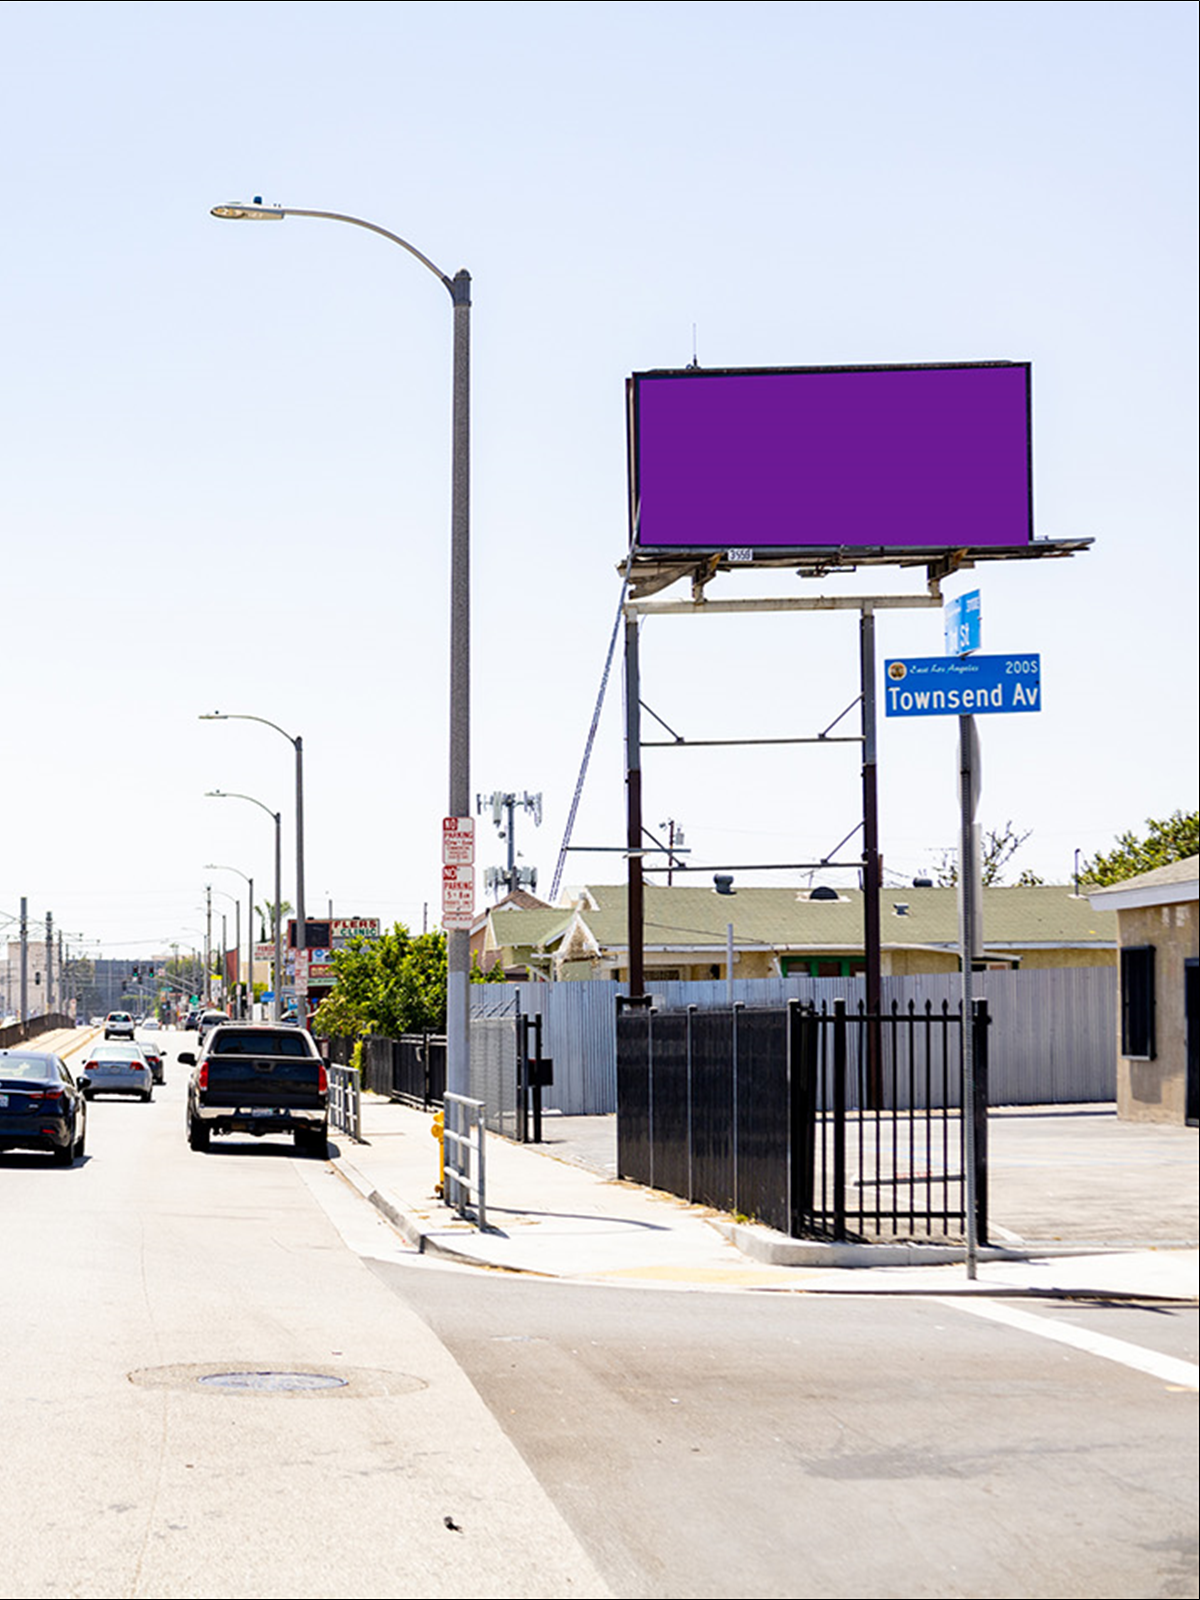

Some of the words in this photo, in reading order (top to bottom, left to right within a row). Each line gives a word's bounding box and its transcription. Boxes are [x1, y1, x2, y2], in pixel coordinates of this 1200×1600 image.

[930, 663, 945, 673] Los
[946, 664, 979, 675] Angeles
[1005, 660, 1039, 675] 200S
[888, 683, 1003, 711] Townsend
[1012, 682, 1039, 706] Av
[334, 920, 377, 929] FLERS
[340, 928, 377, 936] CLINIC
